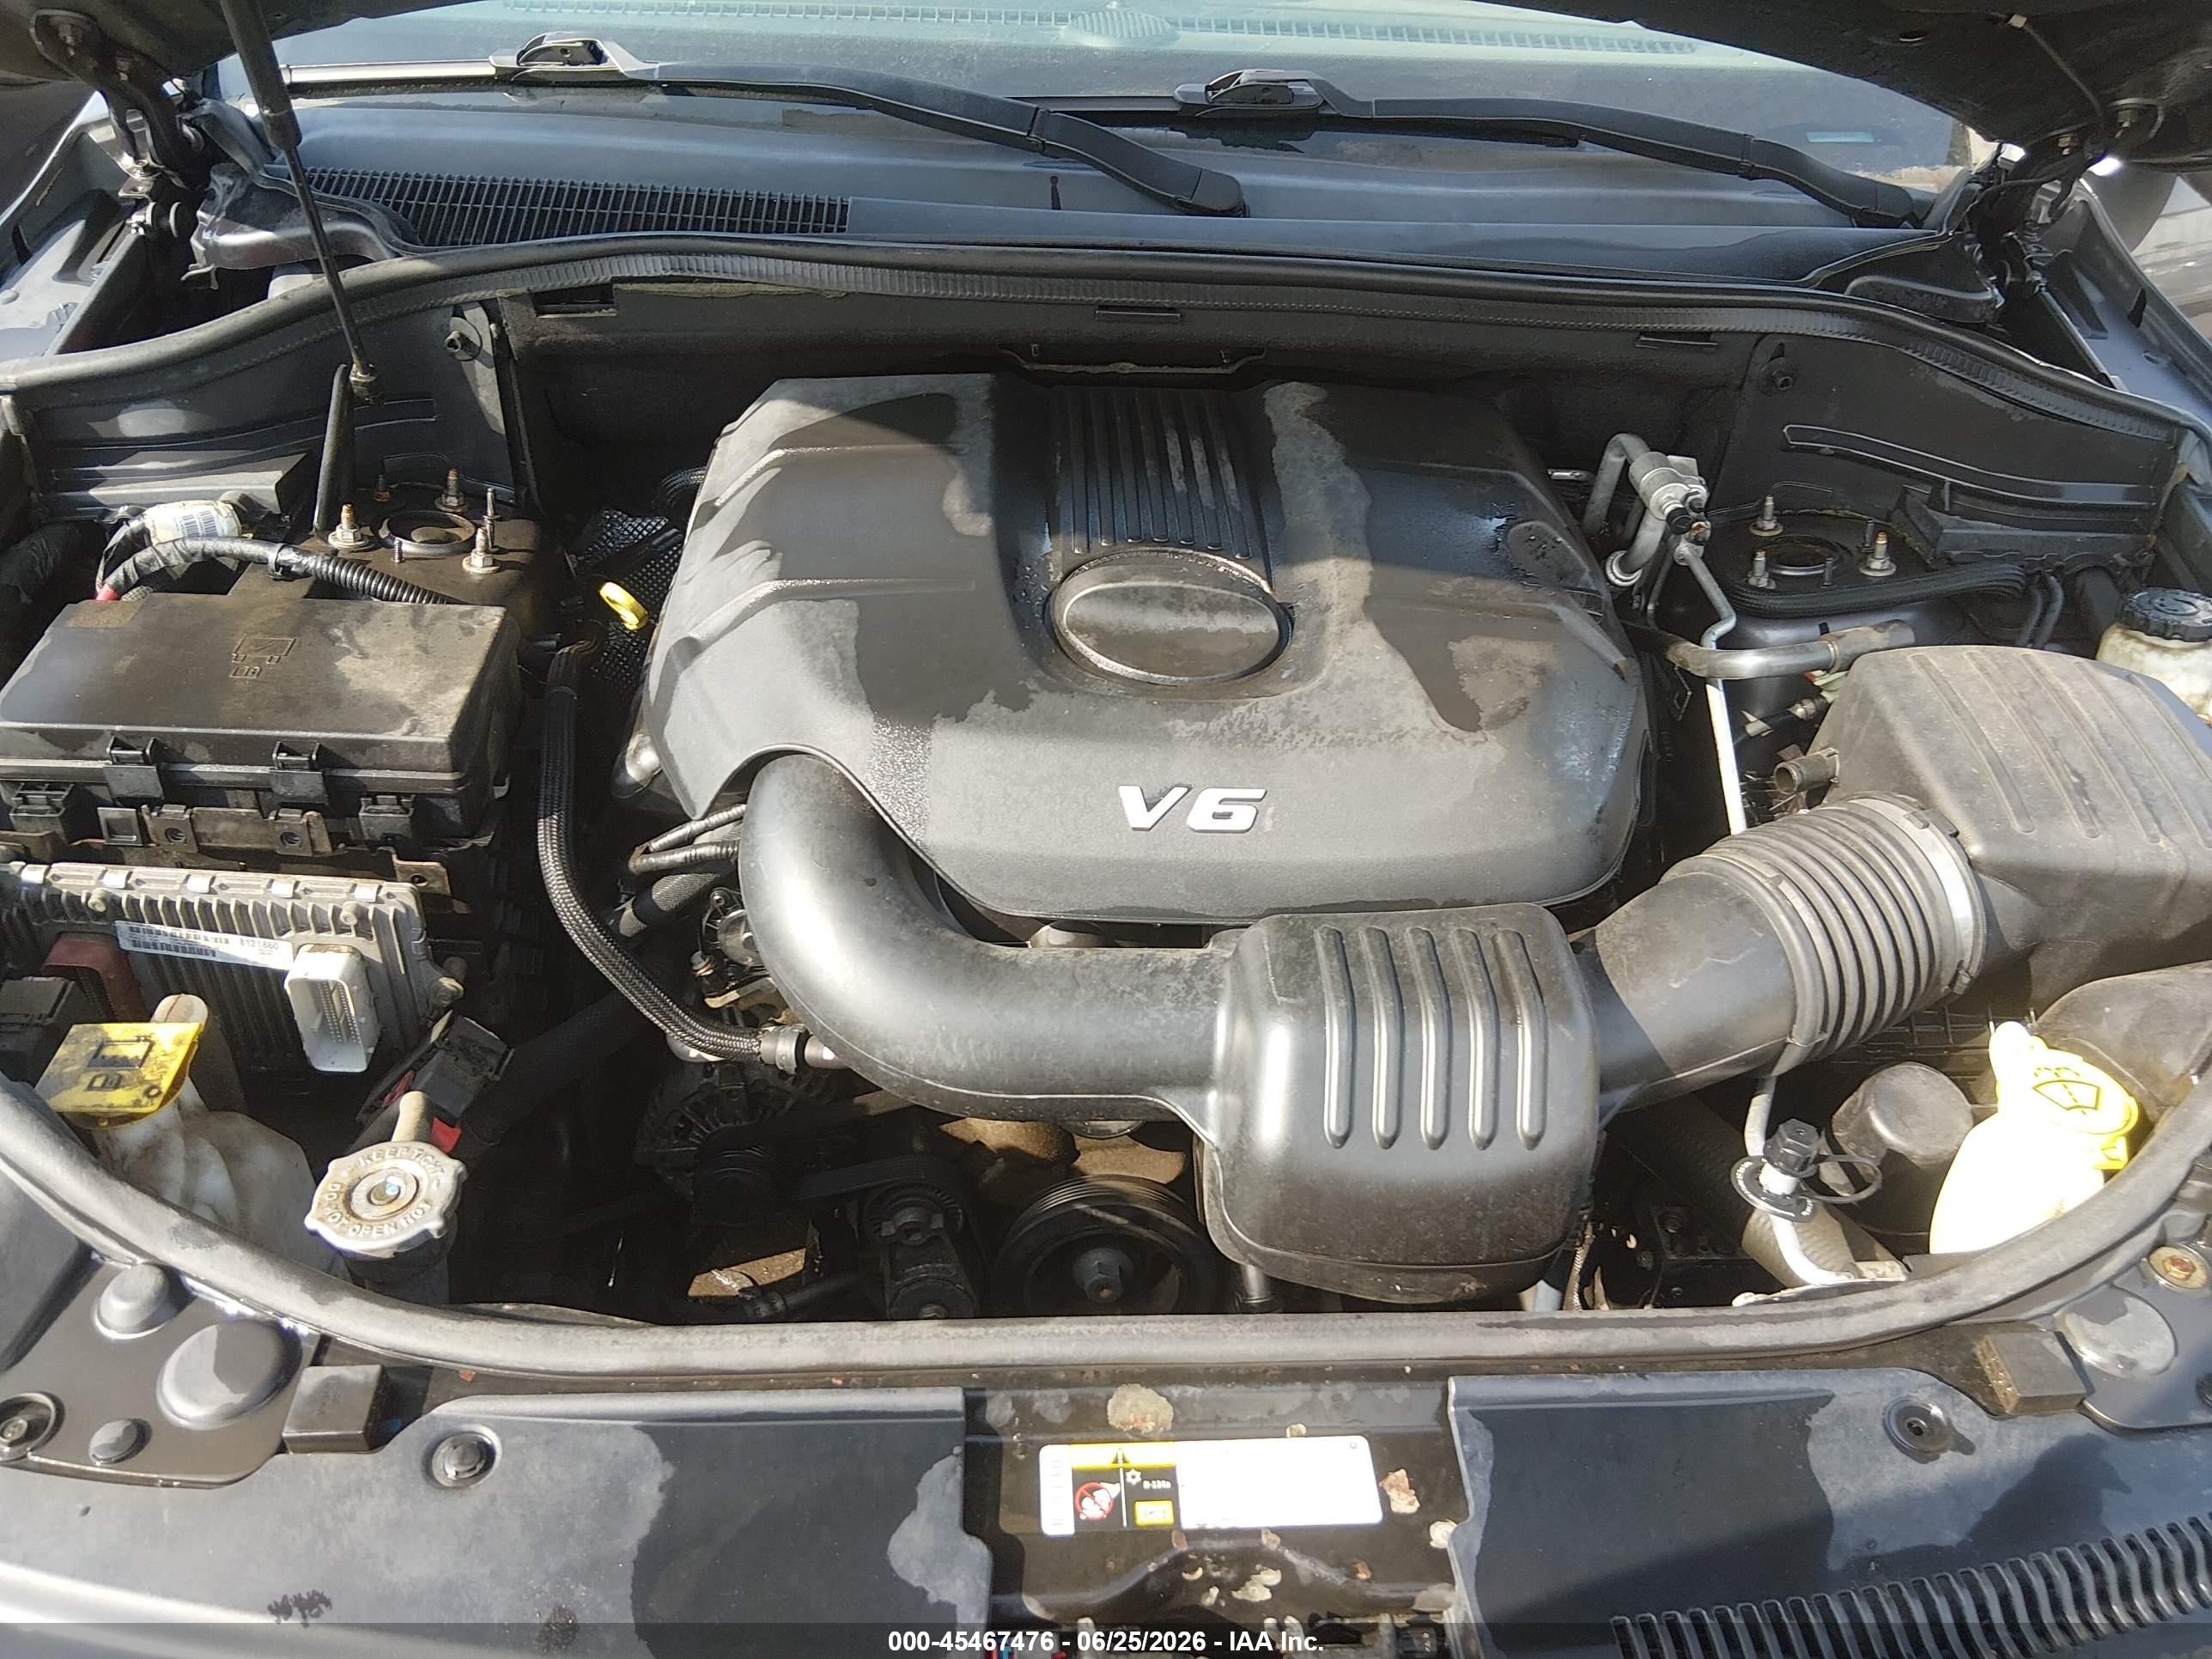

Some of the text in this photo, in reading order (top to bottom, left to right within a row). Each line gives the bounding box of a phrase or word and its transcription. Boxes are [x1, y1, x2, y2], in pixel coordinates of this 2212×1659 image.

[1118, 784, 1268, 834] V6
[357, 1146, 408, 1167] KEEP
[325, 1182, 343, 1202] DO
[348, 1222, 398, 1237] OPEN
[402, 1200, 434, 1228] HOT
